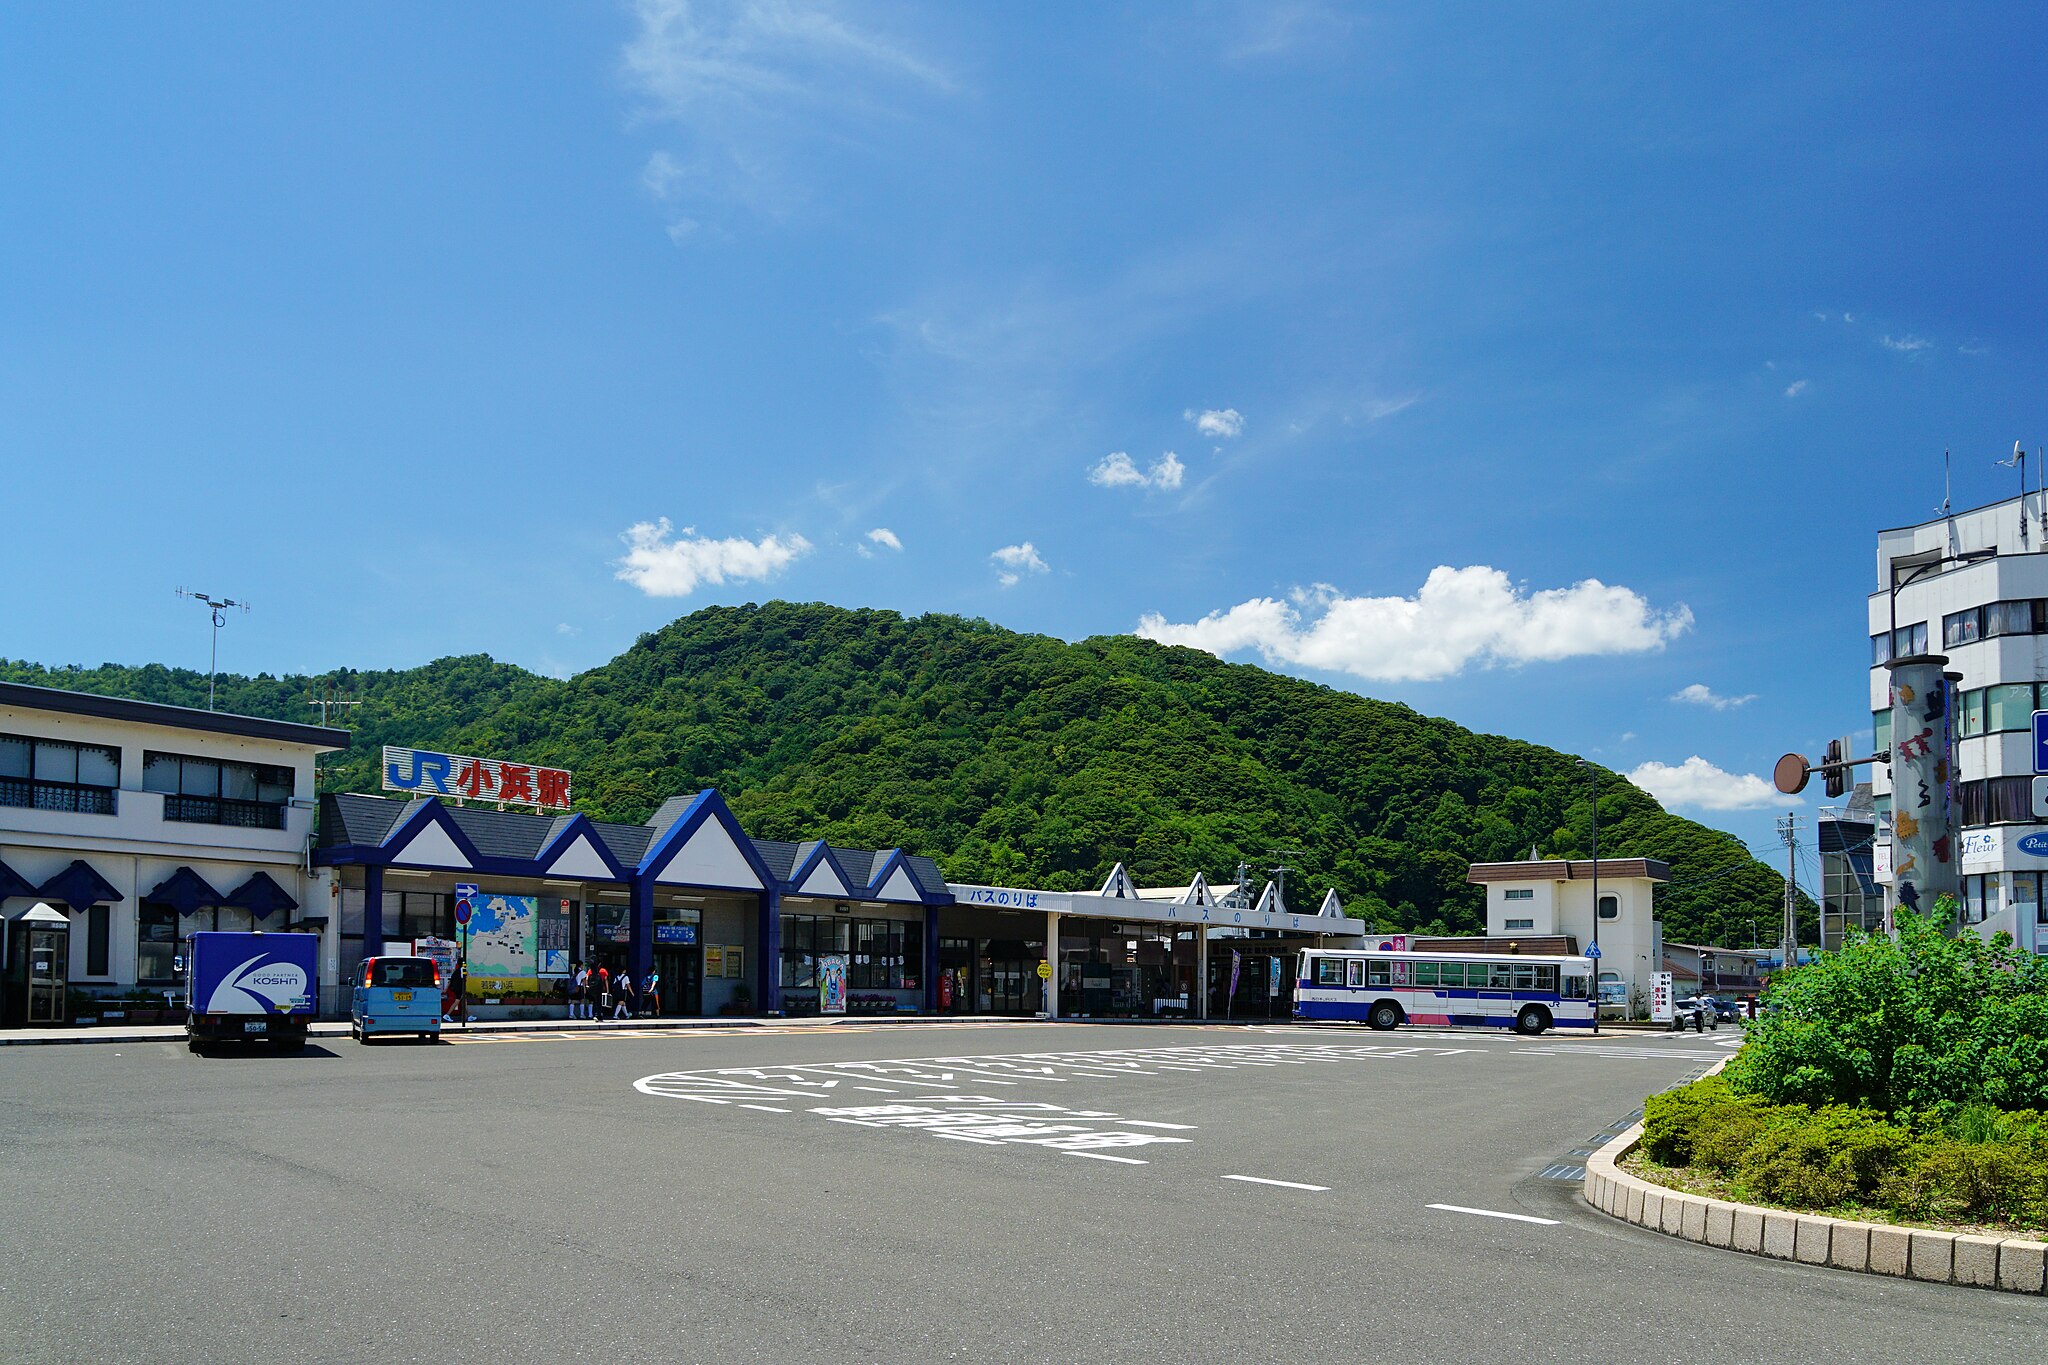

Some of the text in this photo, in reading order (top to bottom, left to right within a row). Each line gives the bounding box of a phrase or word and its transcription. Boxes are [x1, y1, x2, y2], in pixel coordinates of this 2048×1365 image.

[1963, 835, 1997, 854] Fleur
[2025, 837, 2047, 849] Petit
[970, 890, 1038, 907] バスのりば
[1168, 906, 1299, 928] バスのりば
